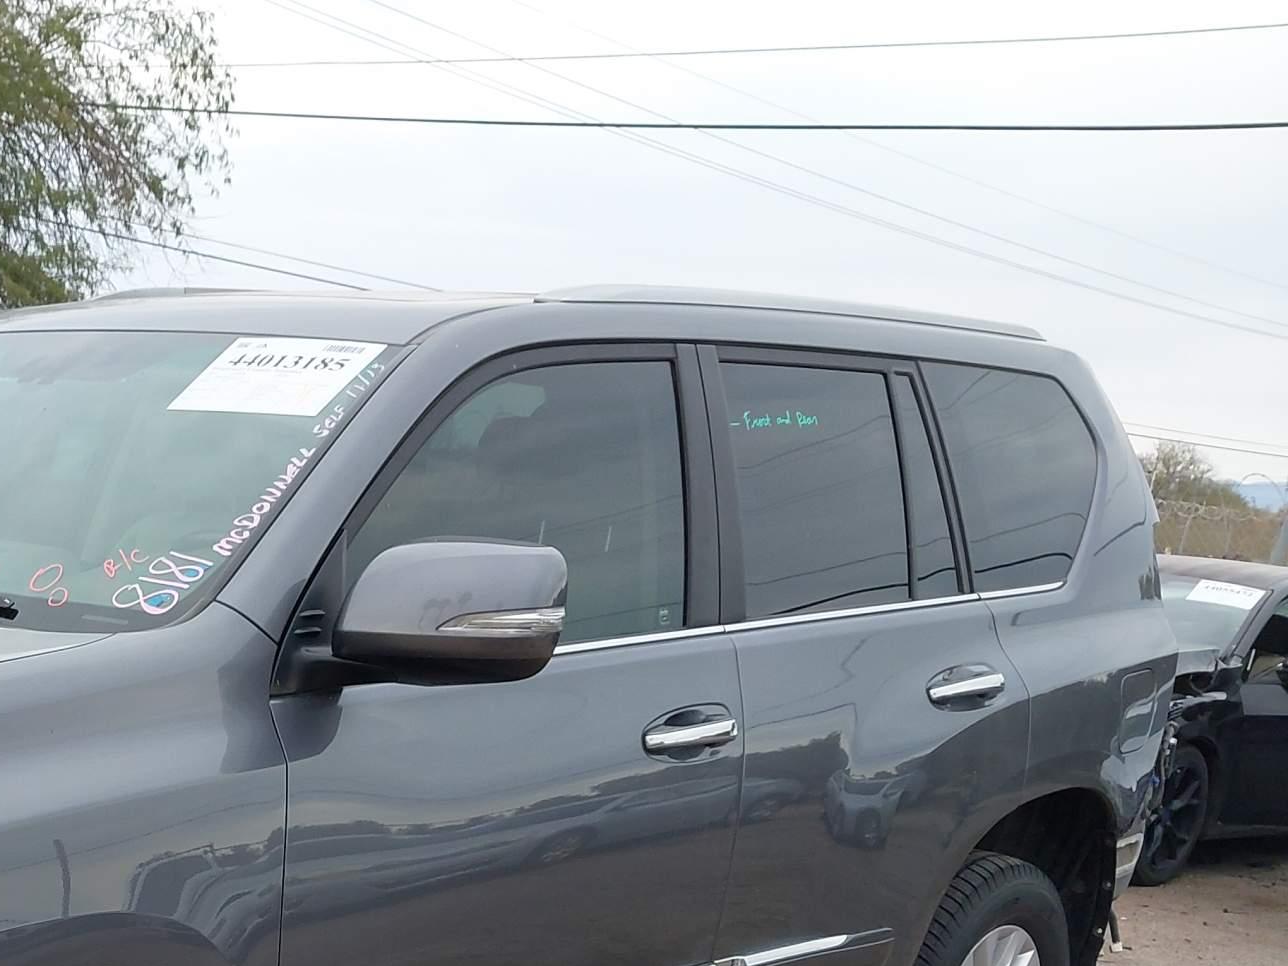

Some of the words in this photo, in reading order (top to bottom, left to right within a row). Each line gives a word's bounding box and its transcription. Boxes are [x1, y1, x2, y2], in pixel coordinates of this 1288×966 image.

[228, 353, 352, 372] 44013185
[776, 410, 791, 425] and
[112, 550, 214, 615] 8181
